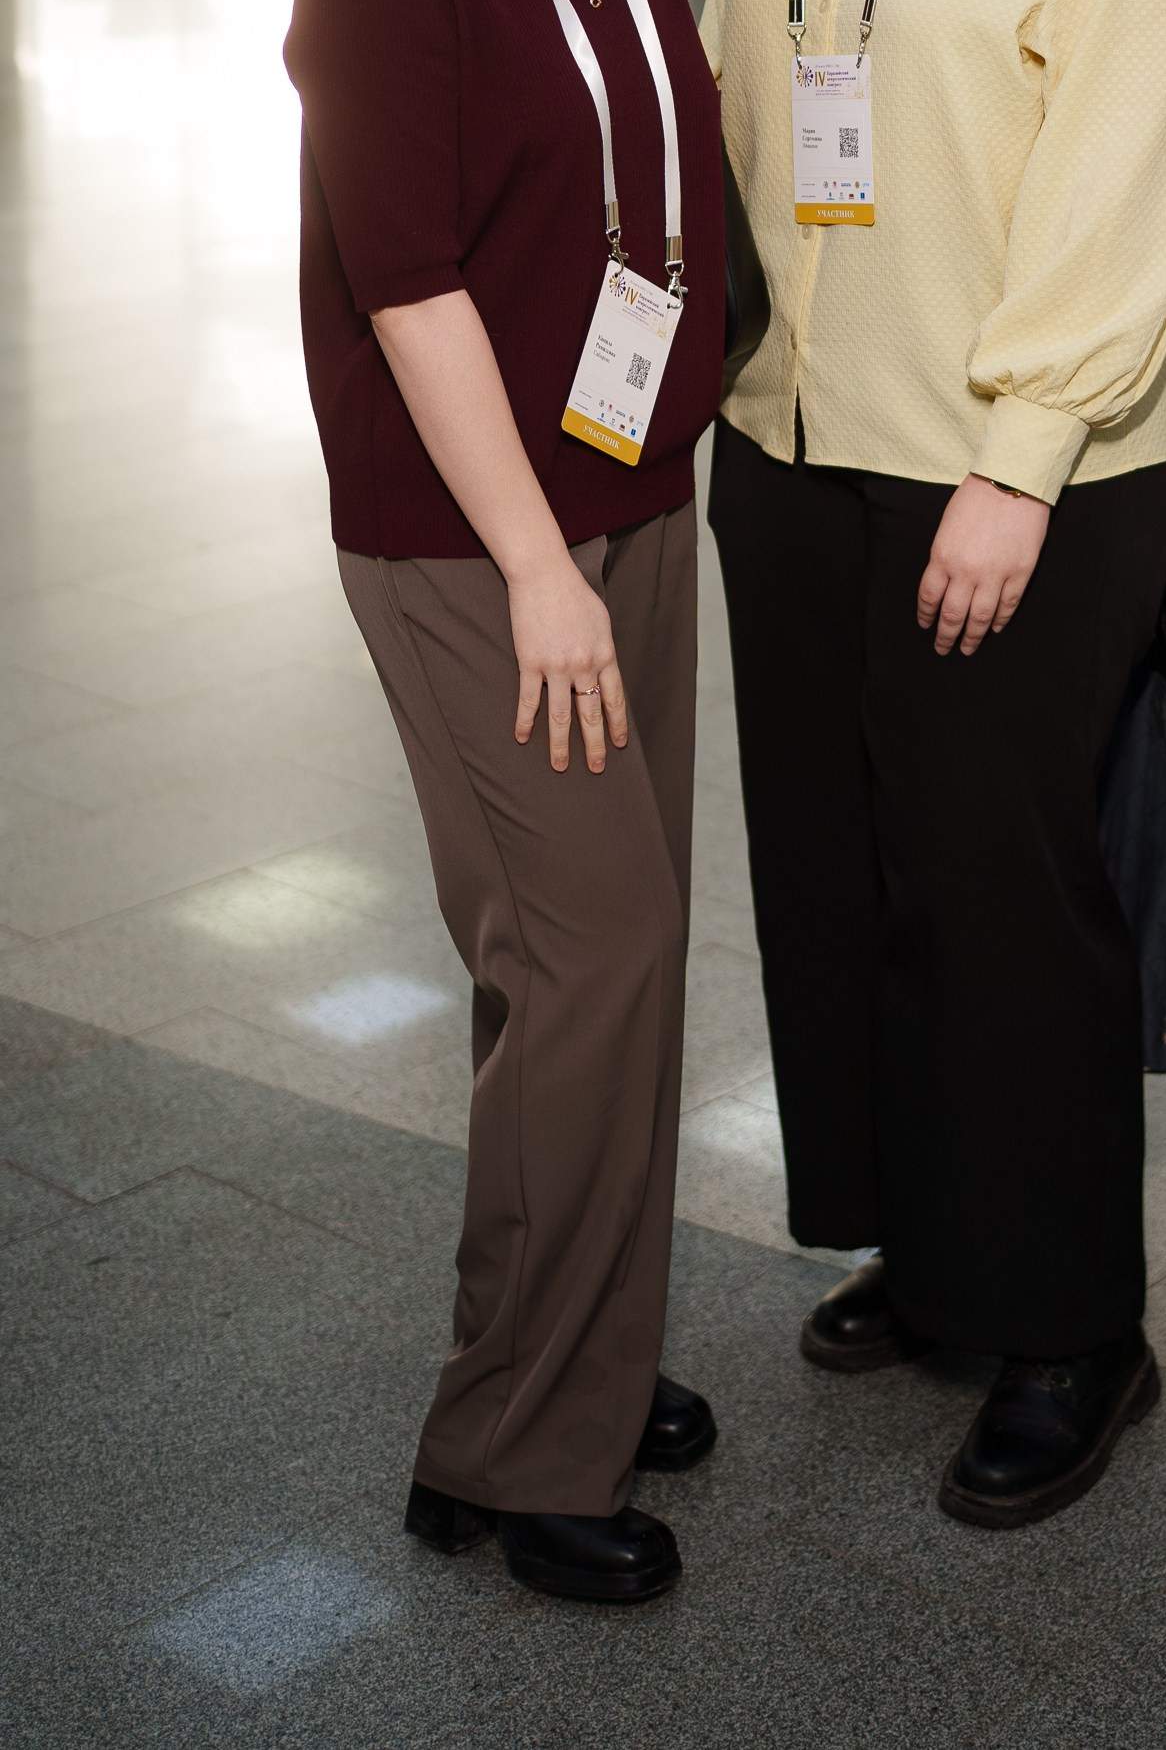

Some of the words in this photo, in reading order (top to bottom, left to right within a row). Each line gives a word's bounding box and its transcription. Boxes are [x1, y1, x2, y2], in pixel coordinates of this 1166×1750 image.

[815, 71, 826, 87] IV
[817, 209, 855, 218] УЧАСТНИК
[624, 286, 639, 306] IV
[583, 424, 621, 450] УЧАСТНИК
